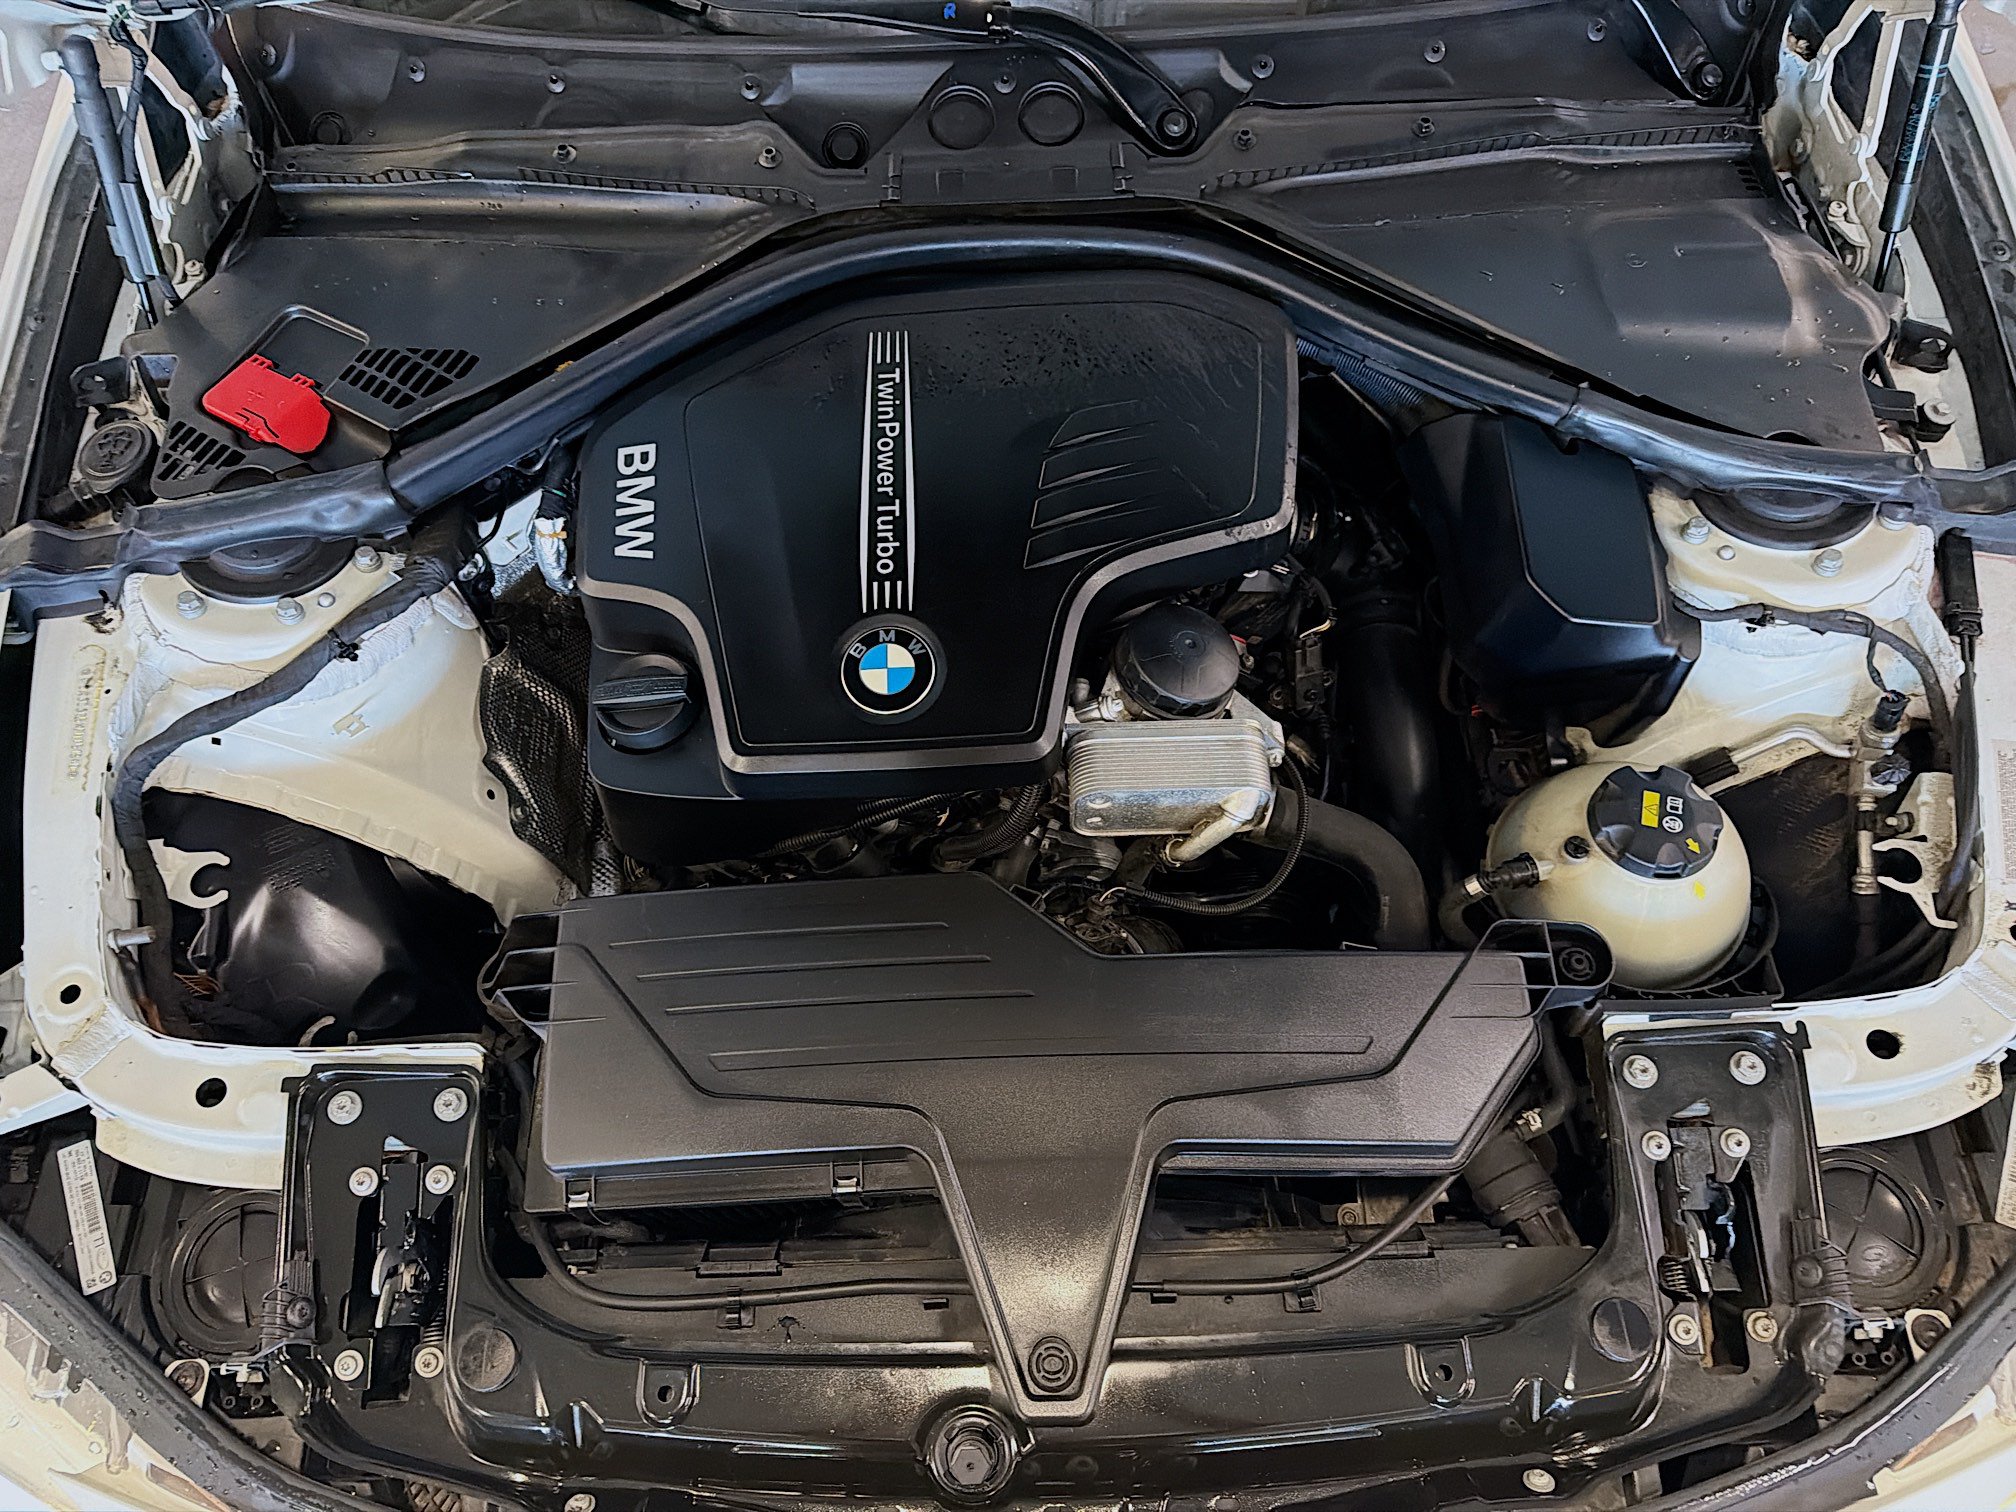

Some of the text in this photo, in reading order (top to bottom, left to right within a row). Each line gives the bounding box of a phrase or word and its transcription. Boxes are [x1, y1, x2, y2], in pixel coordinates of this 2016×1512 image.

[614, 443, 657, 559] BMW
[876, 367, 900, 575] TwinPower Turbo
[849, 629, 926, 658] BMW
